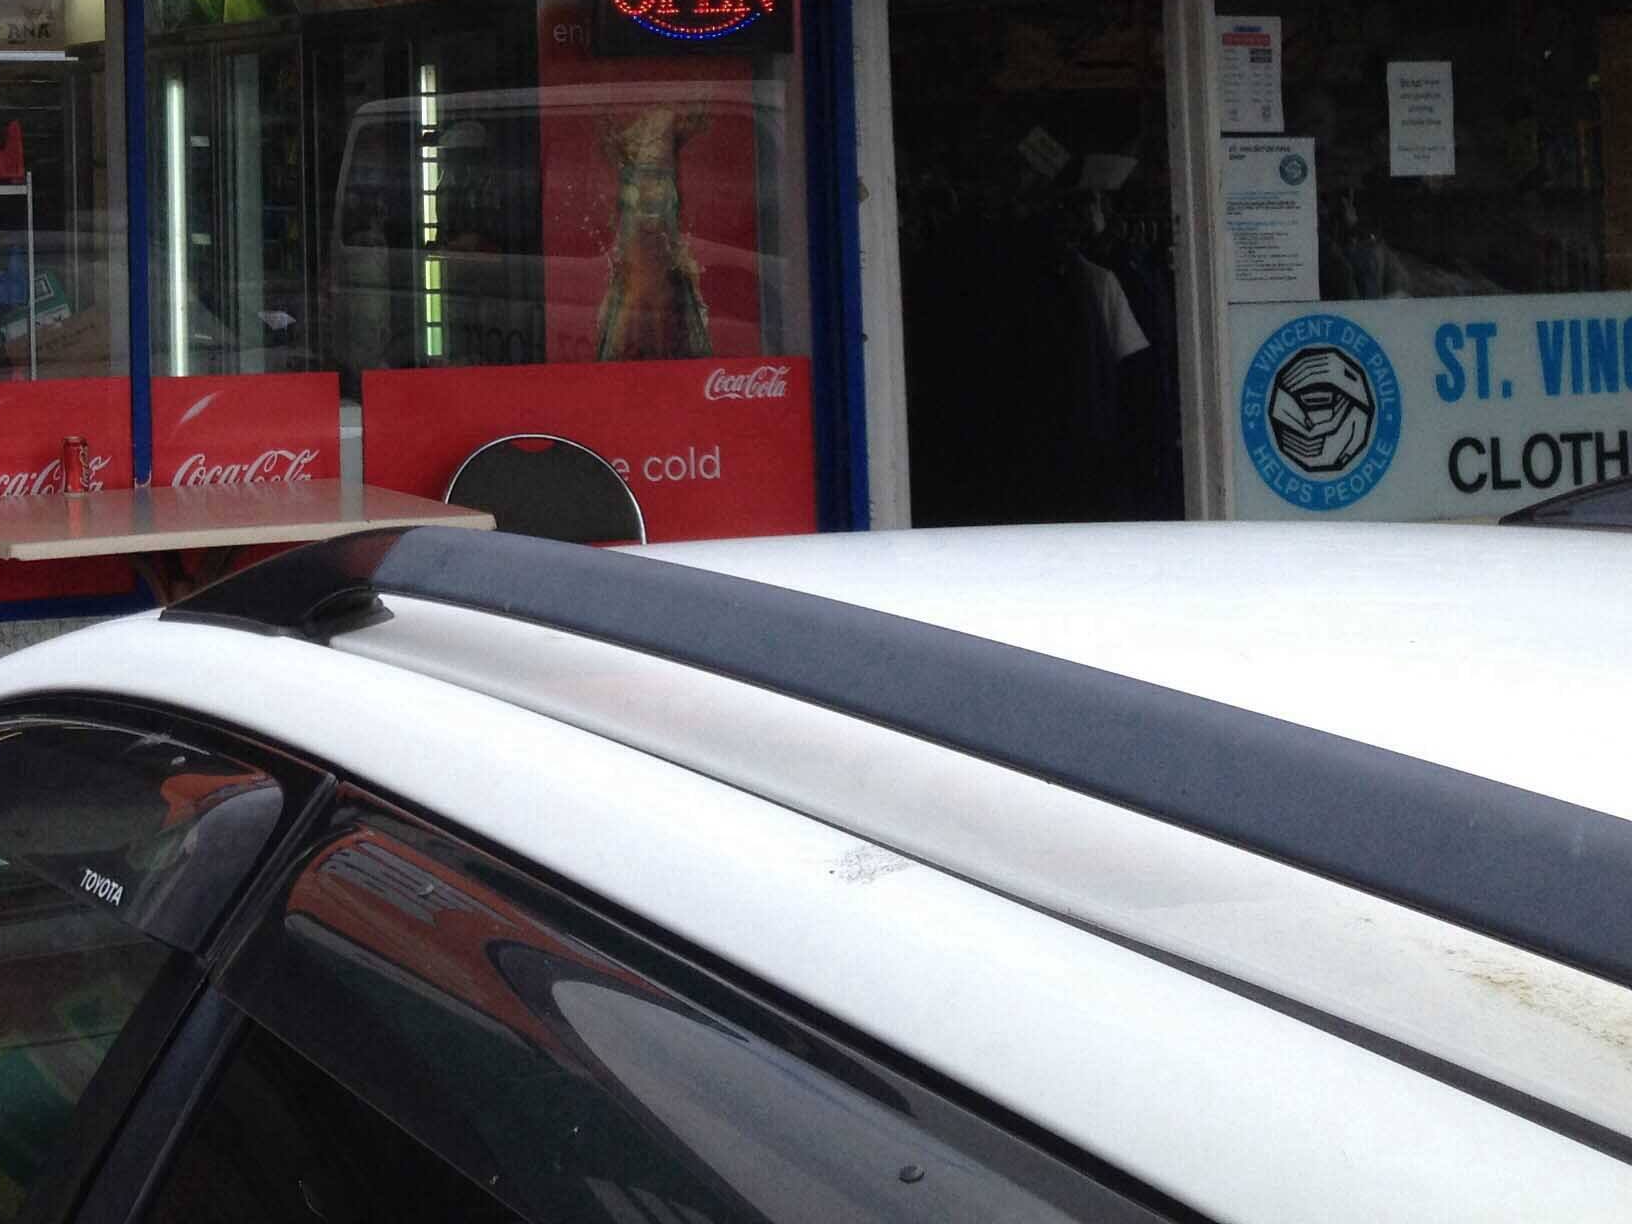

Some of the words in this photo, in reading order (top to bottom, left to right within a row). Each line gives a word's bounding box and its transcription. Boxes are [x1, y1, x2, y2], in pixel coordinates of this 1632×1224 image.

[704, 366, 792, 401] Coca-Cola
[1255, 319, 1334, 372] VINCENT
[1342, 326, 1367, 355] DE
[1366, 353, 1396, 411] PAUL
[1435, 321, 1513, 404] ST.
[643, 445, 722, 482] cold
[1253, 444, 1313, 504] HELPS
[1324, 440, 1393, 504] PEOPLE
[1447, 429, 1630, 494] CLOTH
[79, 868, 124, 906] TOYOTA
